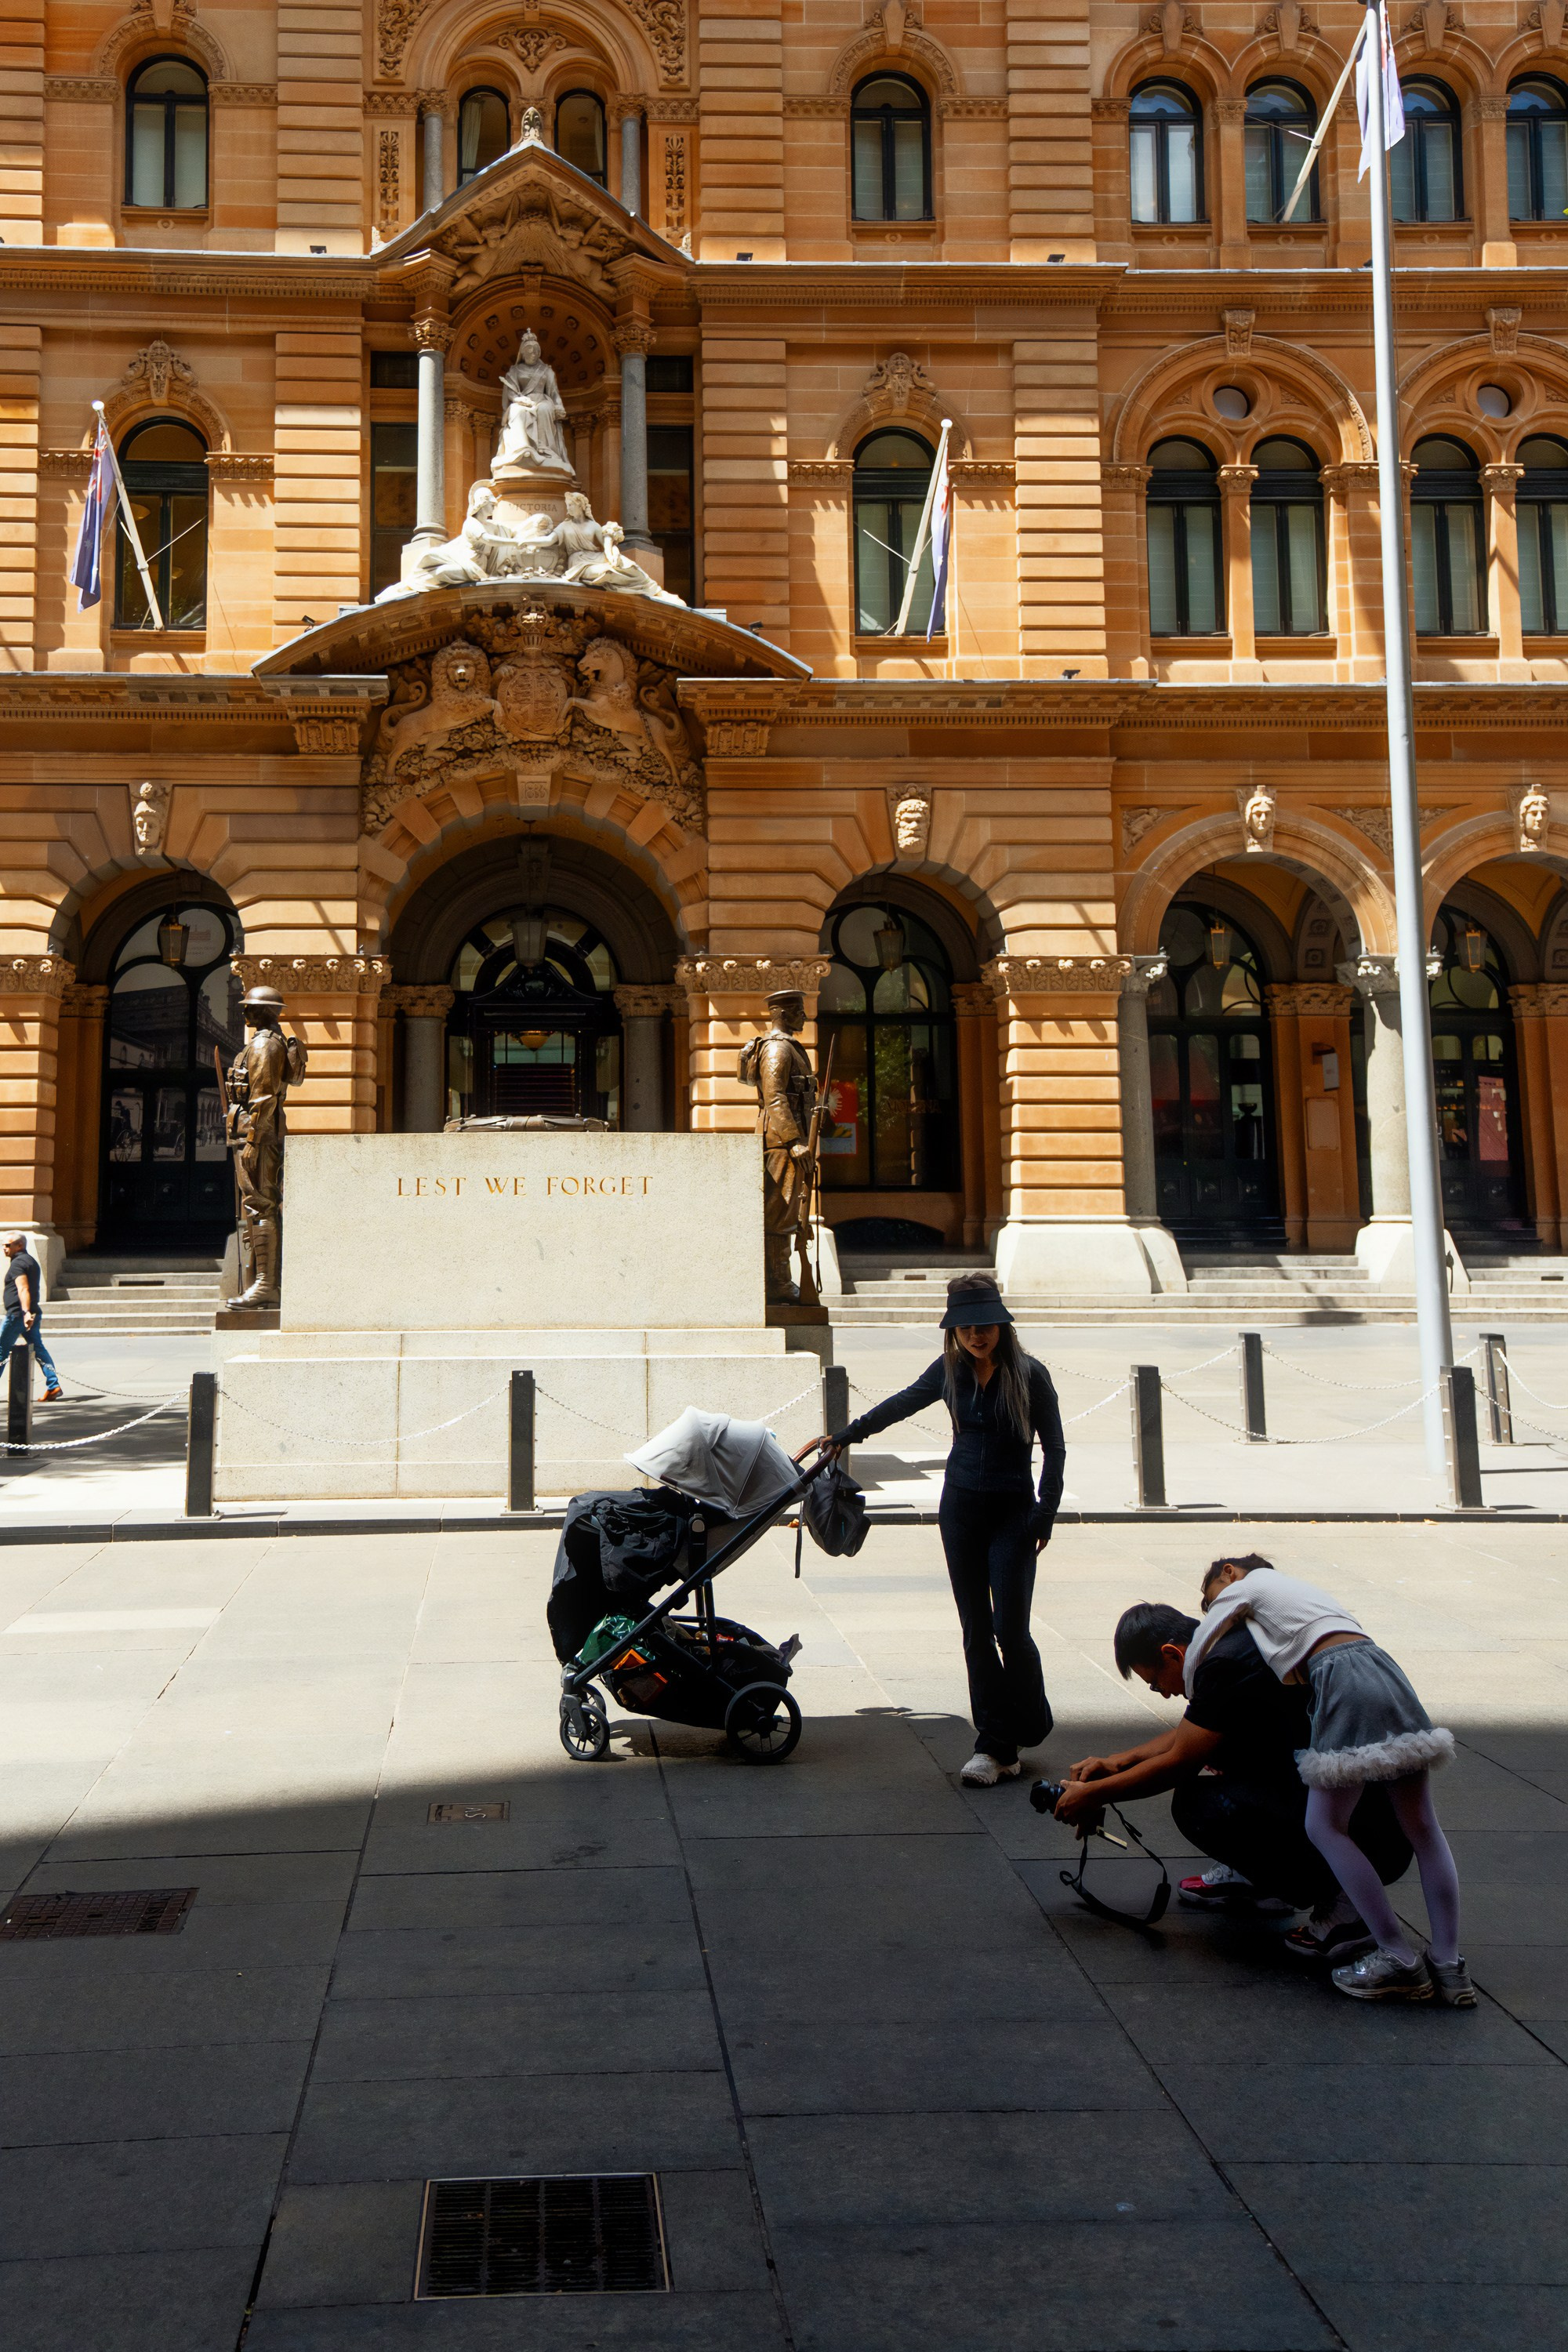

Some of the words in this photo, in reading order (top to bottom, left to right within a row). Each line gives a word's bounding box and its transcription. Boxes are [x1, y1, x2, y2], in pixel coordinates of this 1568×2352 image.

[509, 503, 558, 512] VICTORIA
[396, 1177, 466, 1196] LEST
[485, 1177, 527, 1196] WE
[546, 1176, 654, 1196] FORGET
